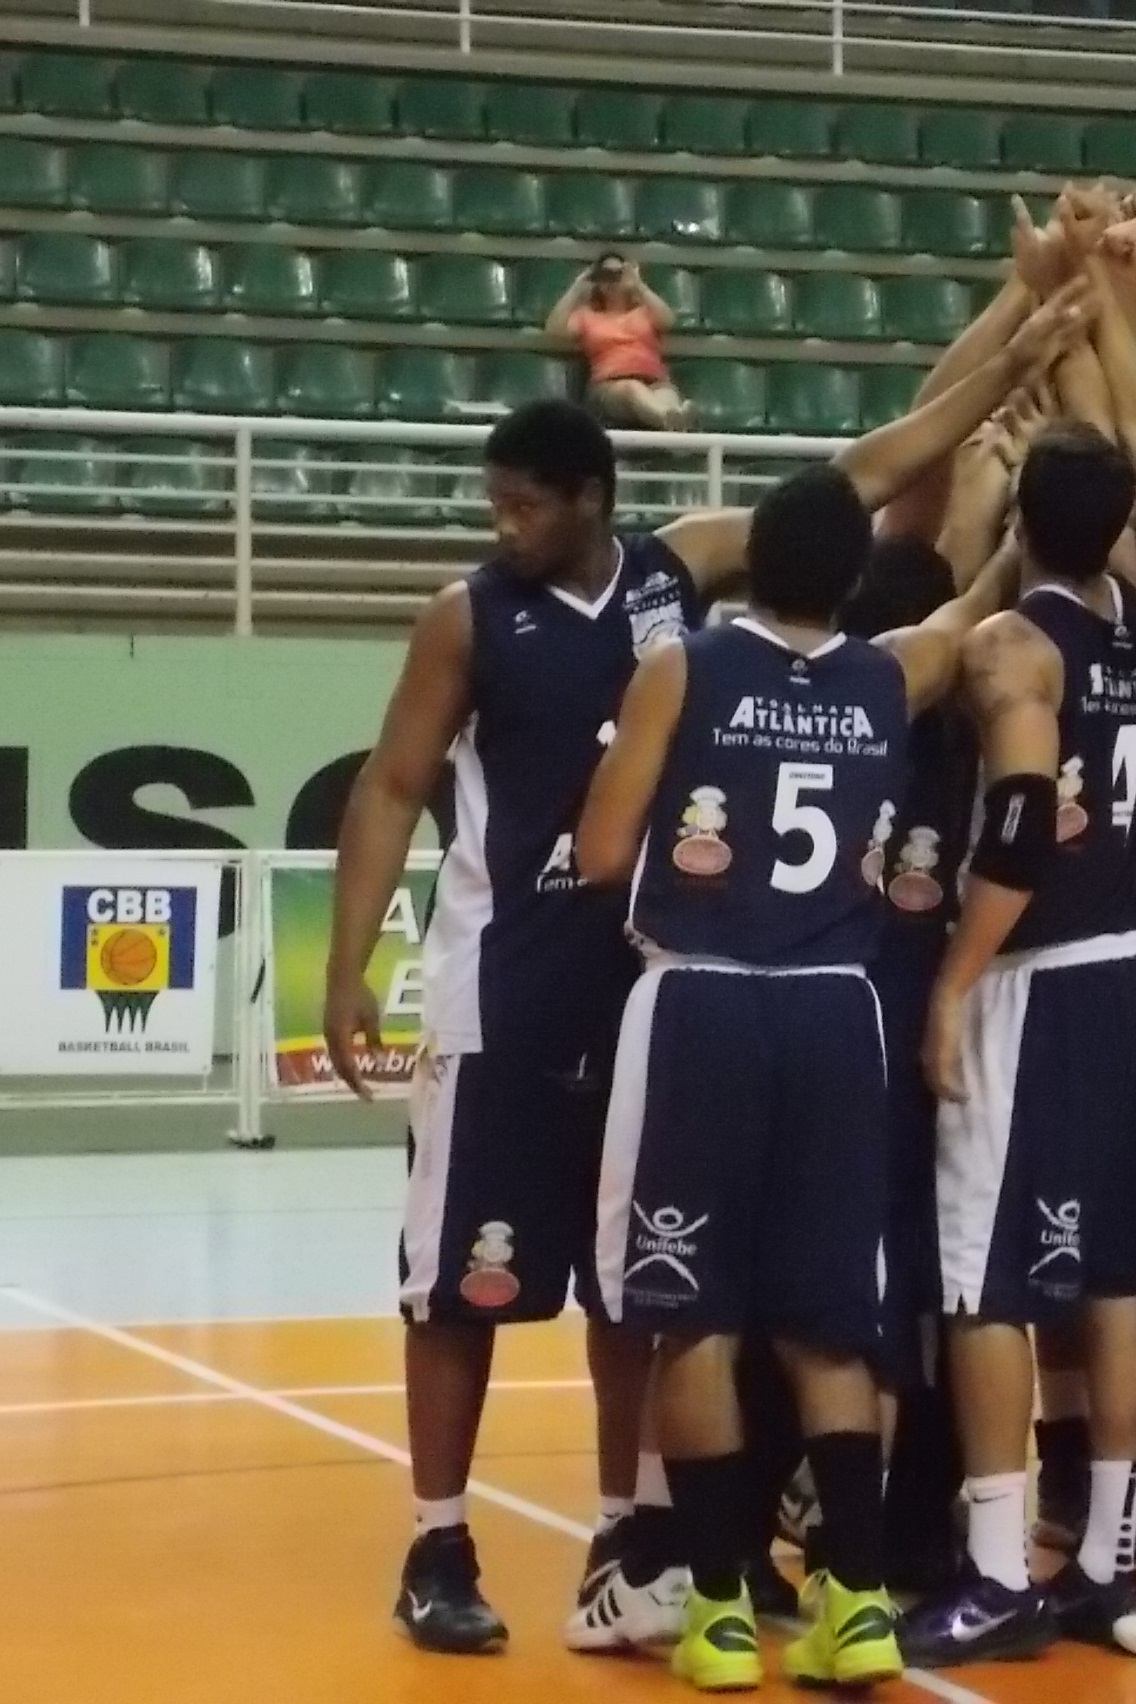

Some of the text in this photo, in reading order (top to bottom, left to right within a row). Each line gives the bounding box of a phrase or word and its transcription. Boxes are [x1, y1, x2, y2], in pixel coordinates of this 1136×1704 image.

[713, 727, 888, 757] Tem as cores do Brasil
[770, 762, 837, 894] 5
[87, 888, 172, 924] CBB
[58, 1041, 190, 1054] BASKETBALL BRASIL
[636, 1234, 698, 1257] Unifebe
